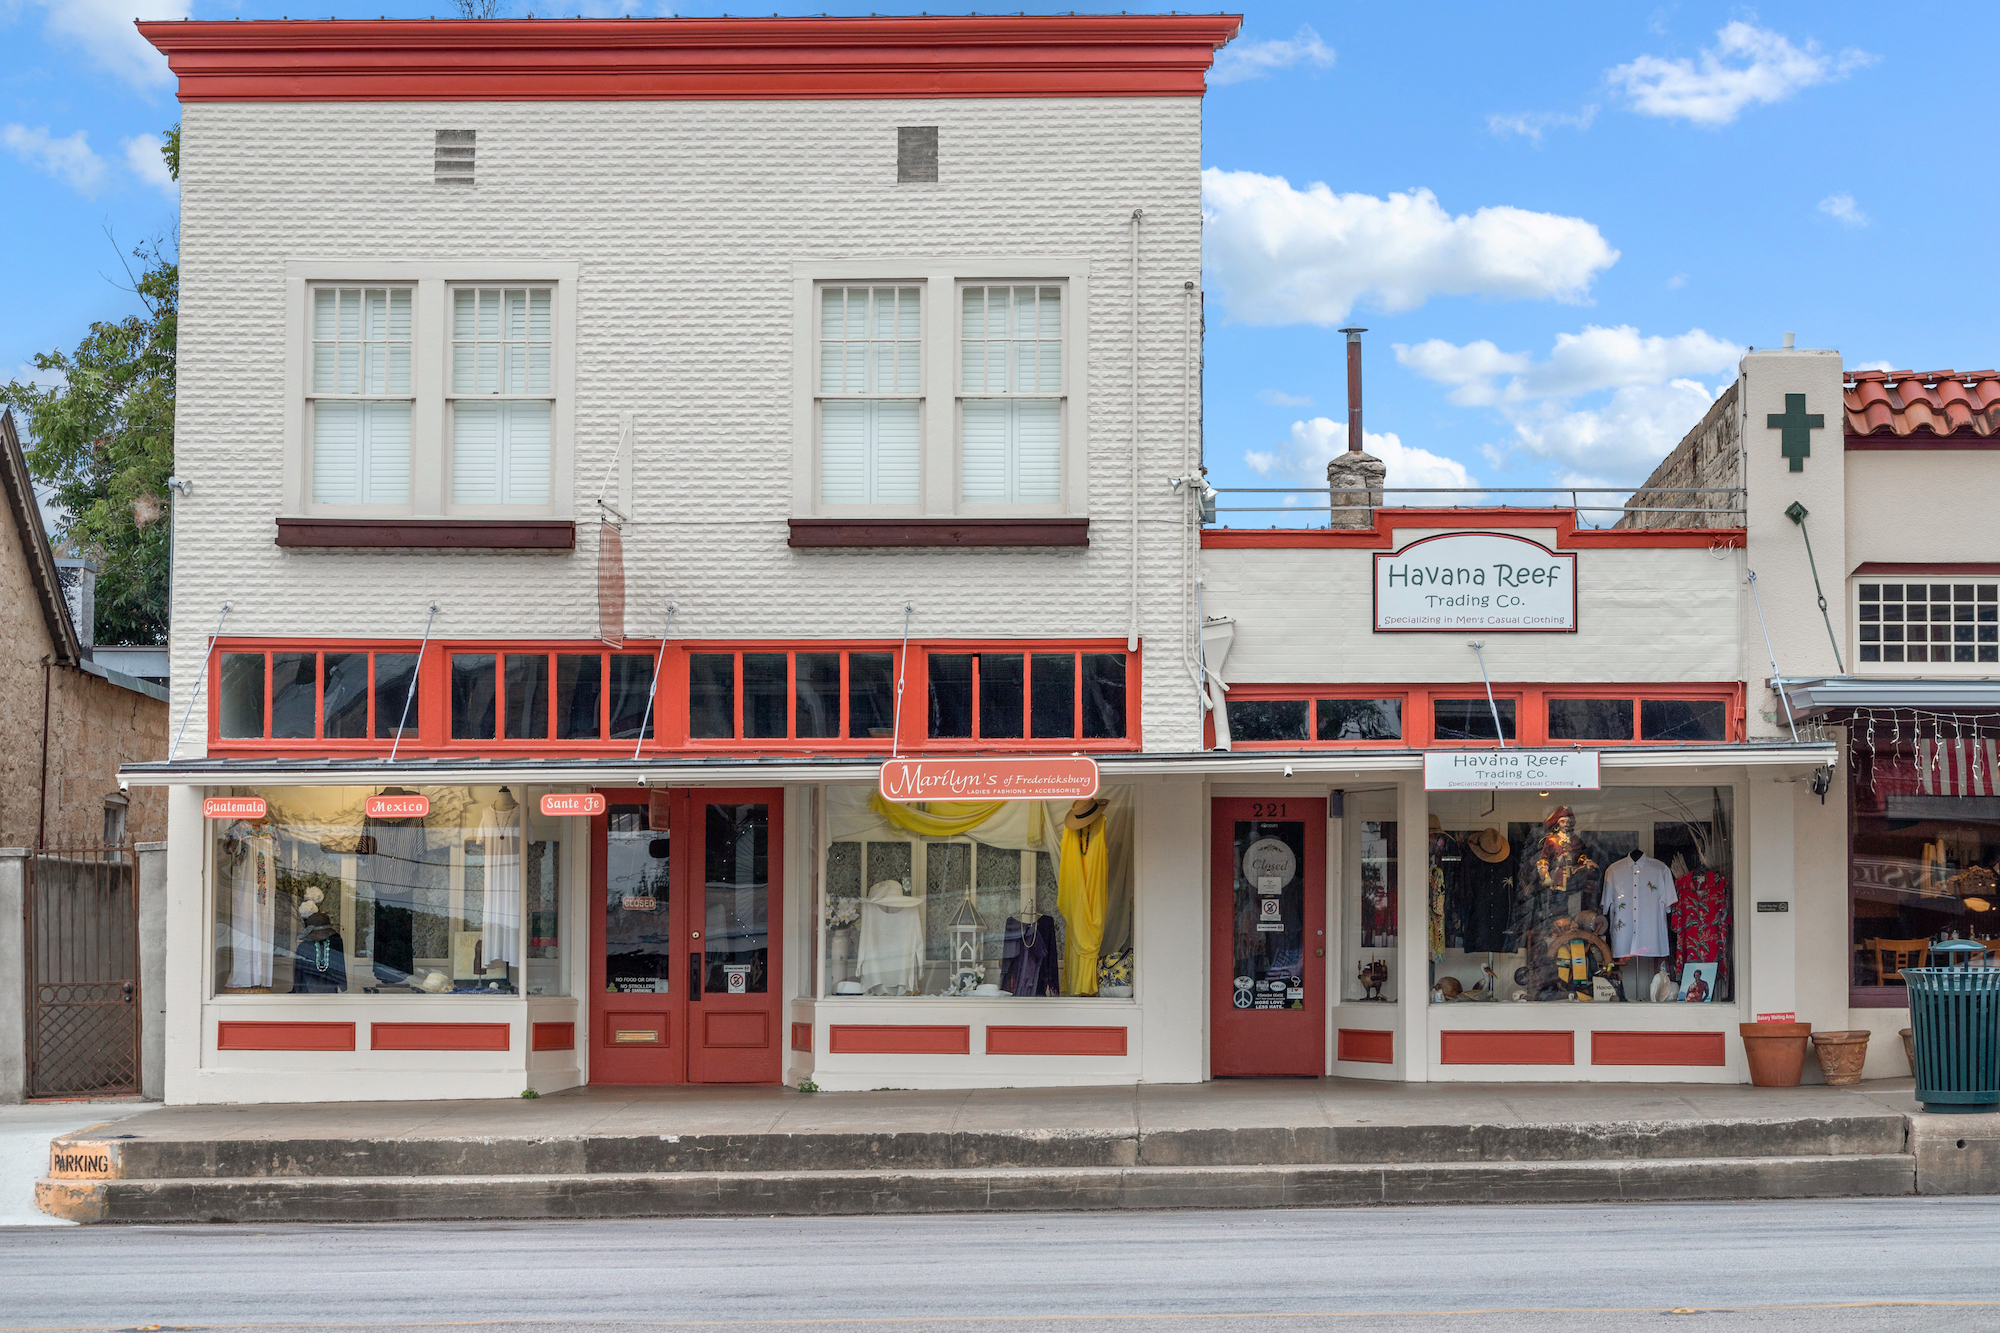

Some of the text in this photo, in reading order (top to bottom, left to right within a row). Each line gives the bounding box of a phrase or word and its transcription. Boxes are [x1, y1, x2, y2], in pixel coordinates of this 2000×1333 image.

[1388, 563, 1561, 588] Havana Reef
[1425, 594, 1525, 608] Trading Co.
[1384, 615, 1565, 626] Specializing in Men's Casual Clothing
[1454, 754, 1569, 768] Havana Reef
[889, 764, 1092, 795] Marilyn's of Fredericksburg
[1475, 769, 1548, 780] Trading Co.
[205, 800, 264, 815] Guatemala
[372, 800, 423, 813] Mexico
[546, 796, 600, 812] Sante Fe
[1252, 803, 1287, 818] 221
[1252, 858, 1289, 871] Closed
[624, 899, 655, 908] CLOSED
[54, 1154, 108, 1173] PARKING
